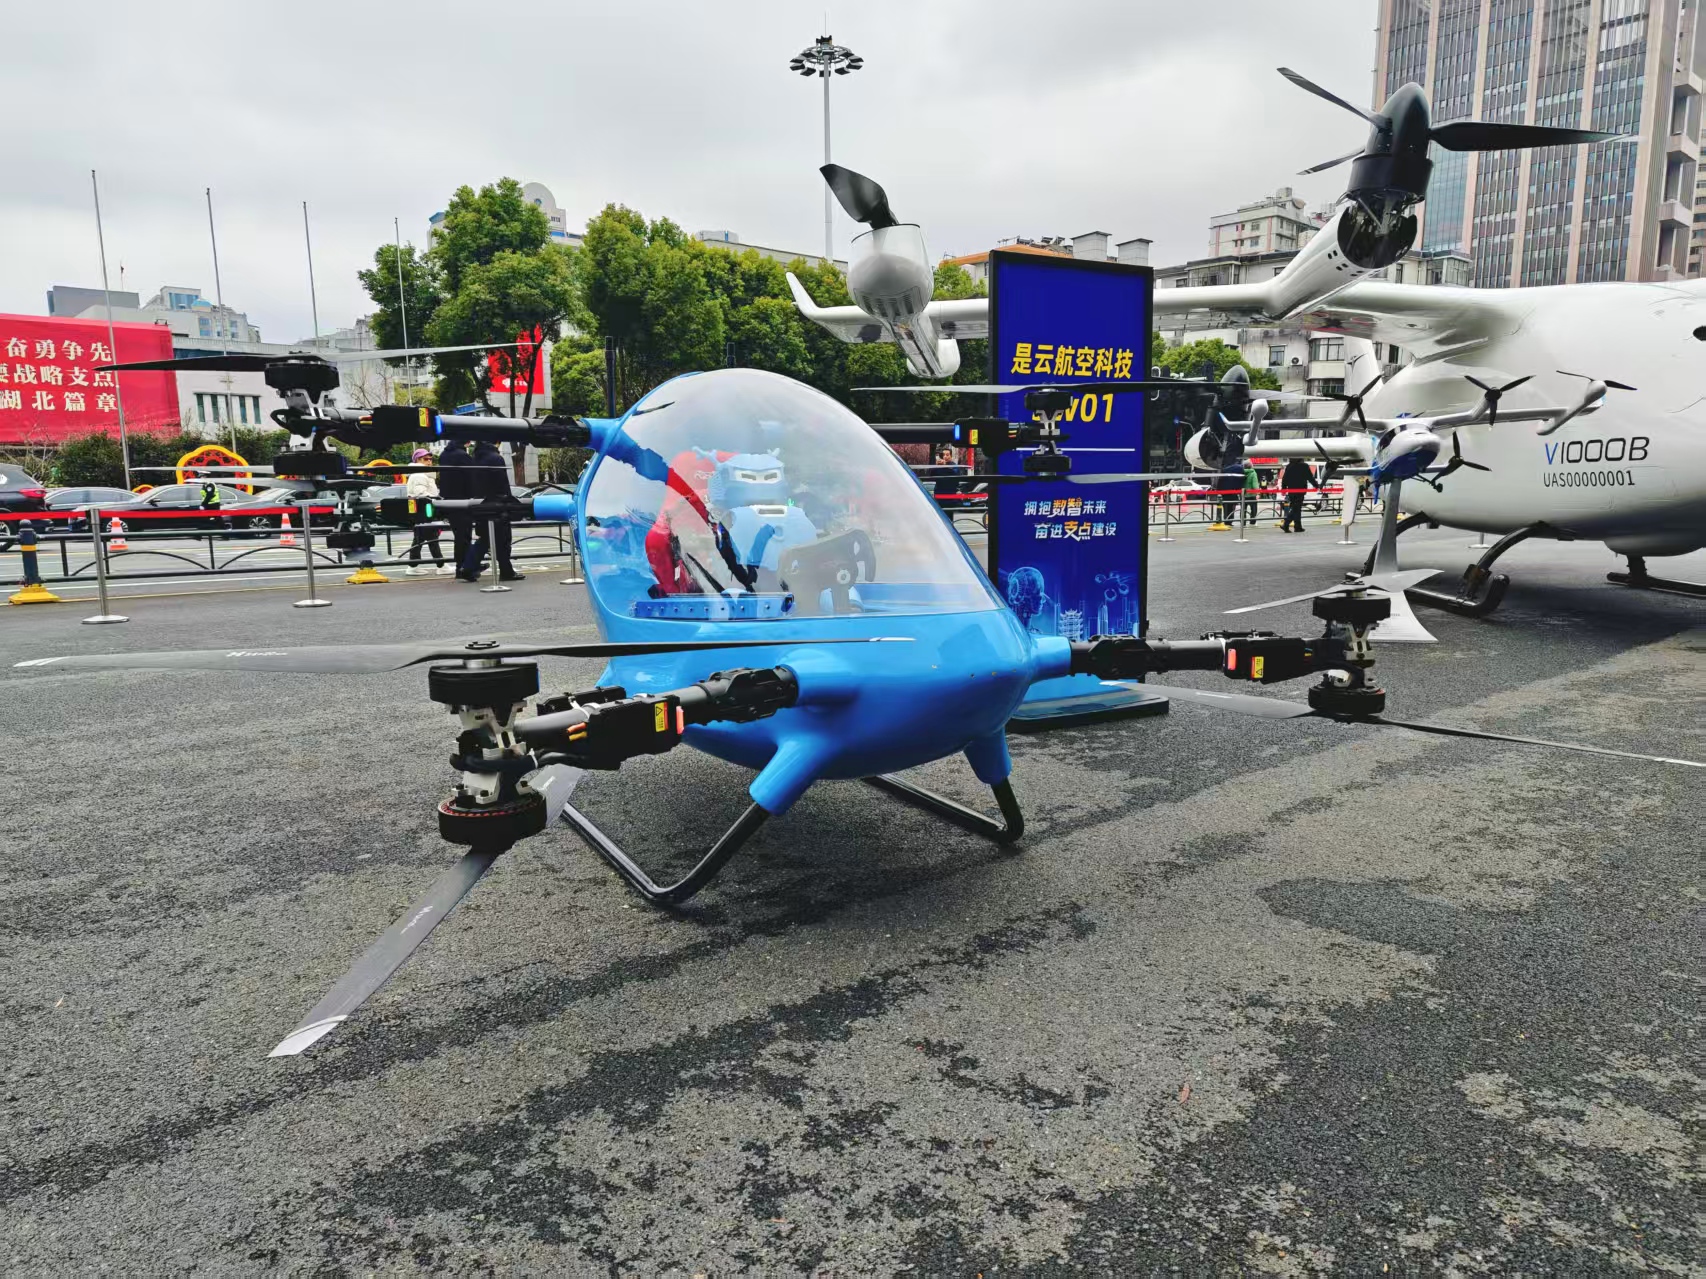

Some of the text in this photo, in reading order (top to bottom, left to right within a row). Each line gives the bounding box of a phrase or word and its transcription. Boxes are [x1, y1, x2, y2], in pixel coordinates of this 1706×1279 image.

[5, 337, 112, 362] 奋勇争先
[1011, 342, 1134, 379] 是云航空科技
[1545, 437, 1650, 465] V1000B
[1543, 470, 1636, 487] UAS00000001
[1024, 498, 1107, 518] 拥抱数智未来
[1034, 521, 1117, 541] 奋进支点建设
